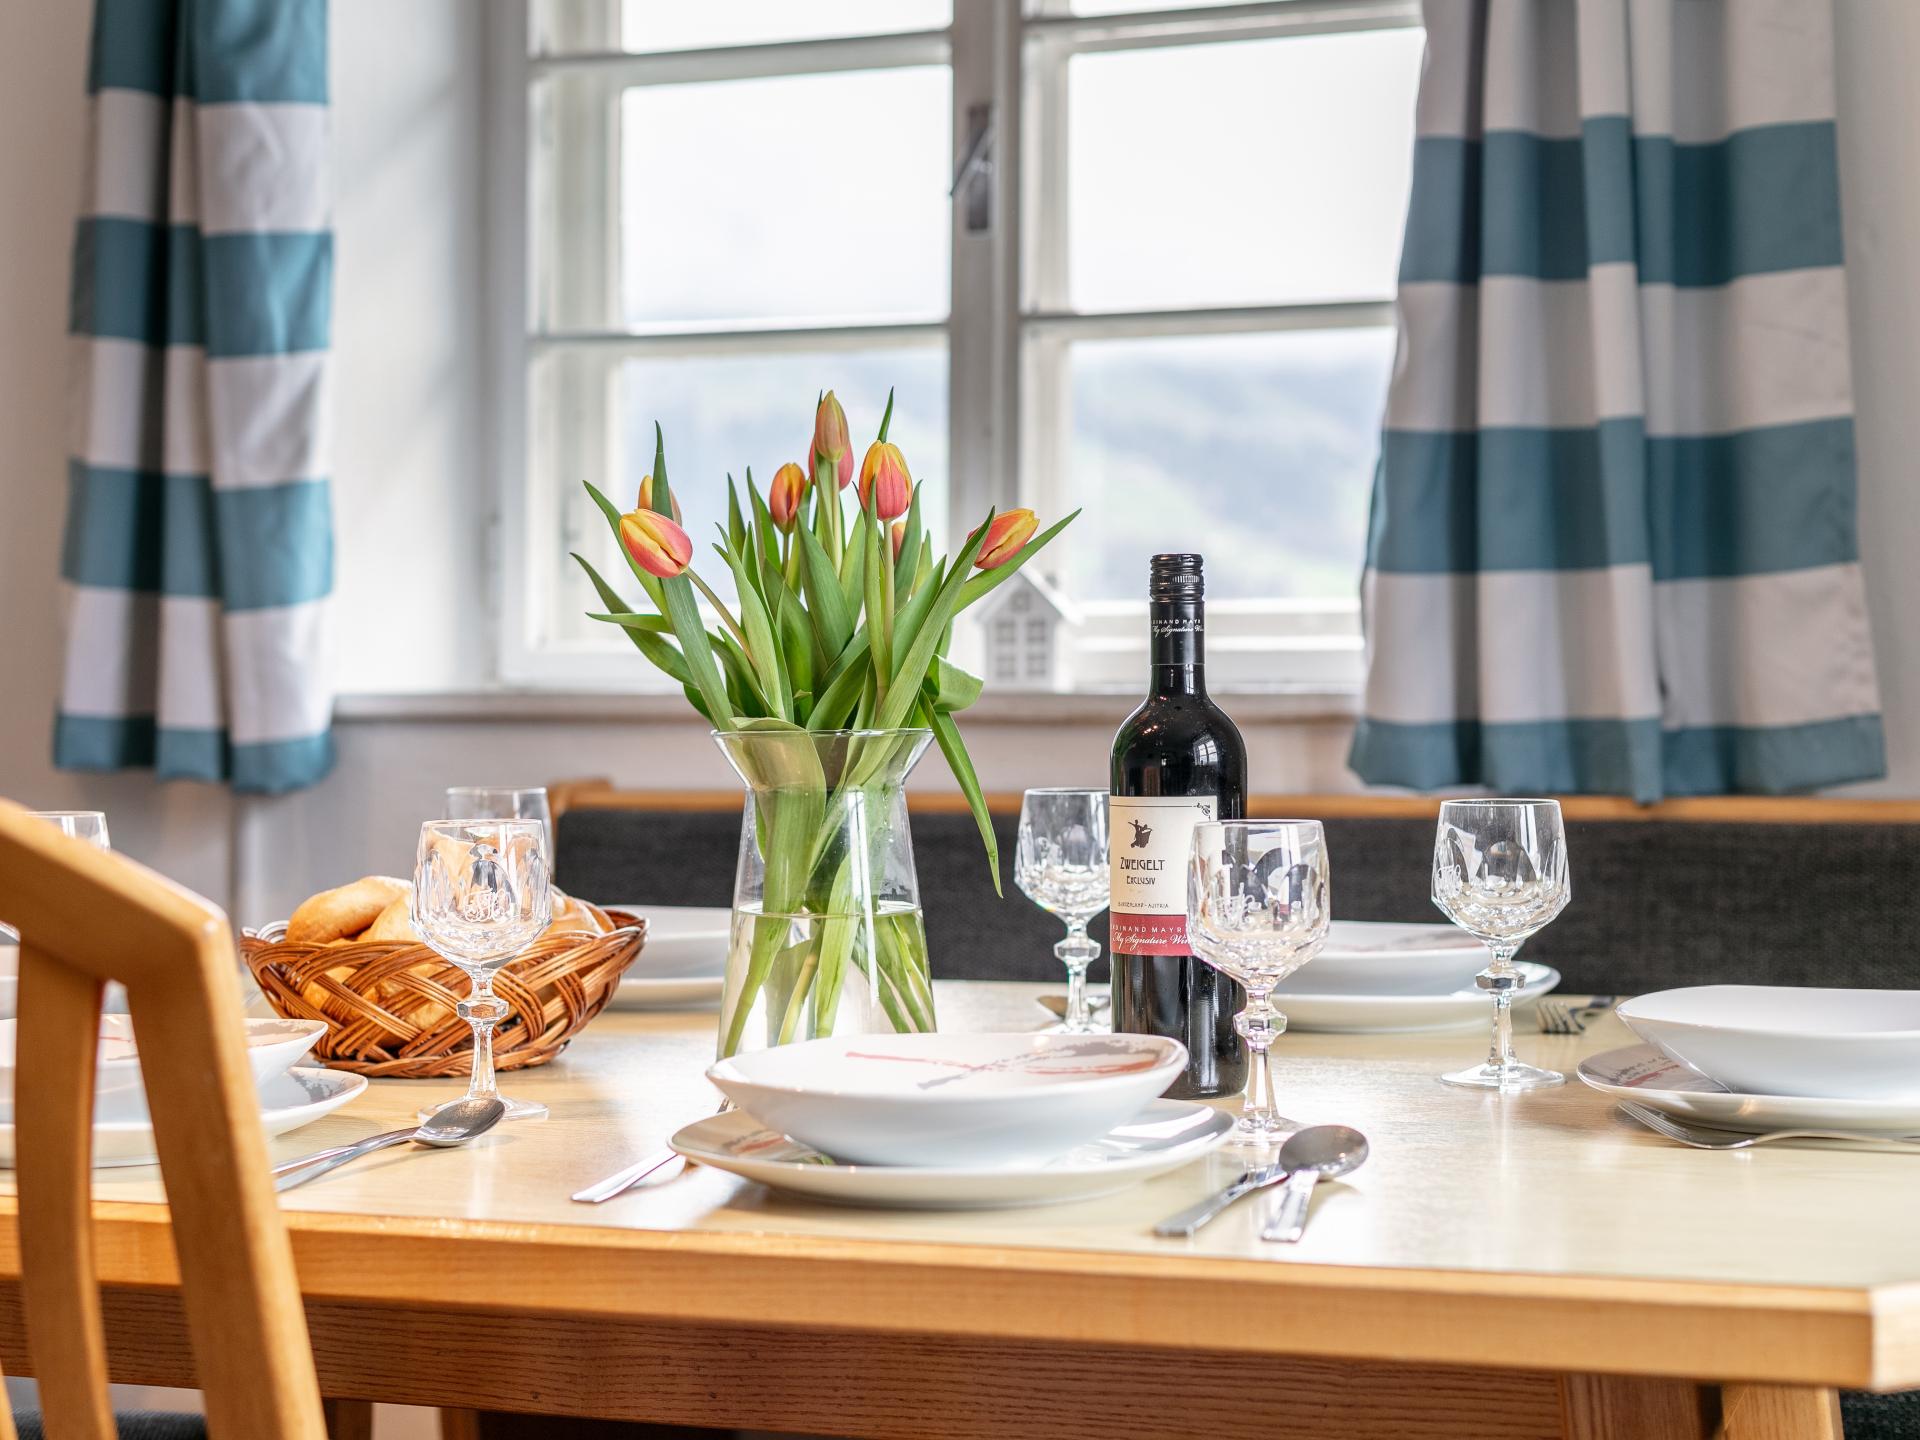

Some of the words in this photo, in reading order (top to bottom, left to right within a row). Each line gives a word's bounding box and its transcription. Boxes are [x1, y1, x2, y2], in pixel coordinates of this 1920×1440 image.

[1160, 625, 1194, 638] Signature
[1120, 856, 1166, 871] ZWEIGELT
[1126, 875, 1156, 885] EXCLUSIV
[1125, 934, 1168, 952] Signature
[1170, 934, 1190, 945] Win
